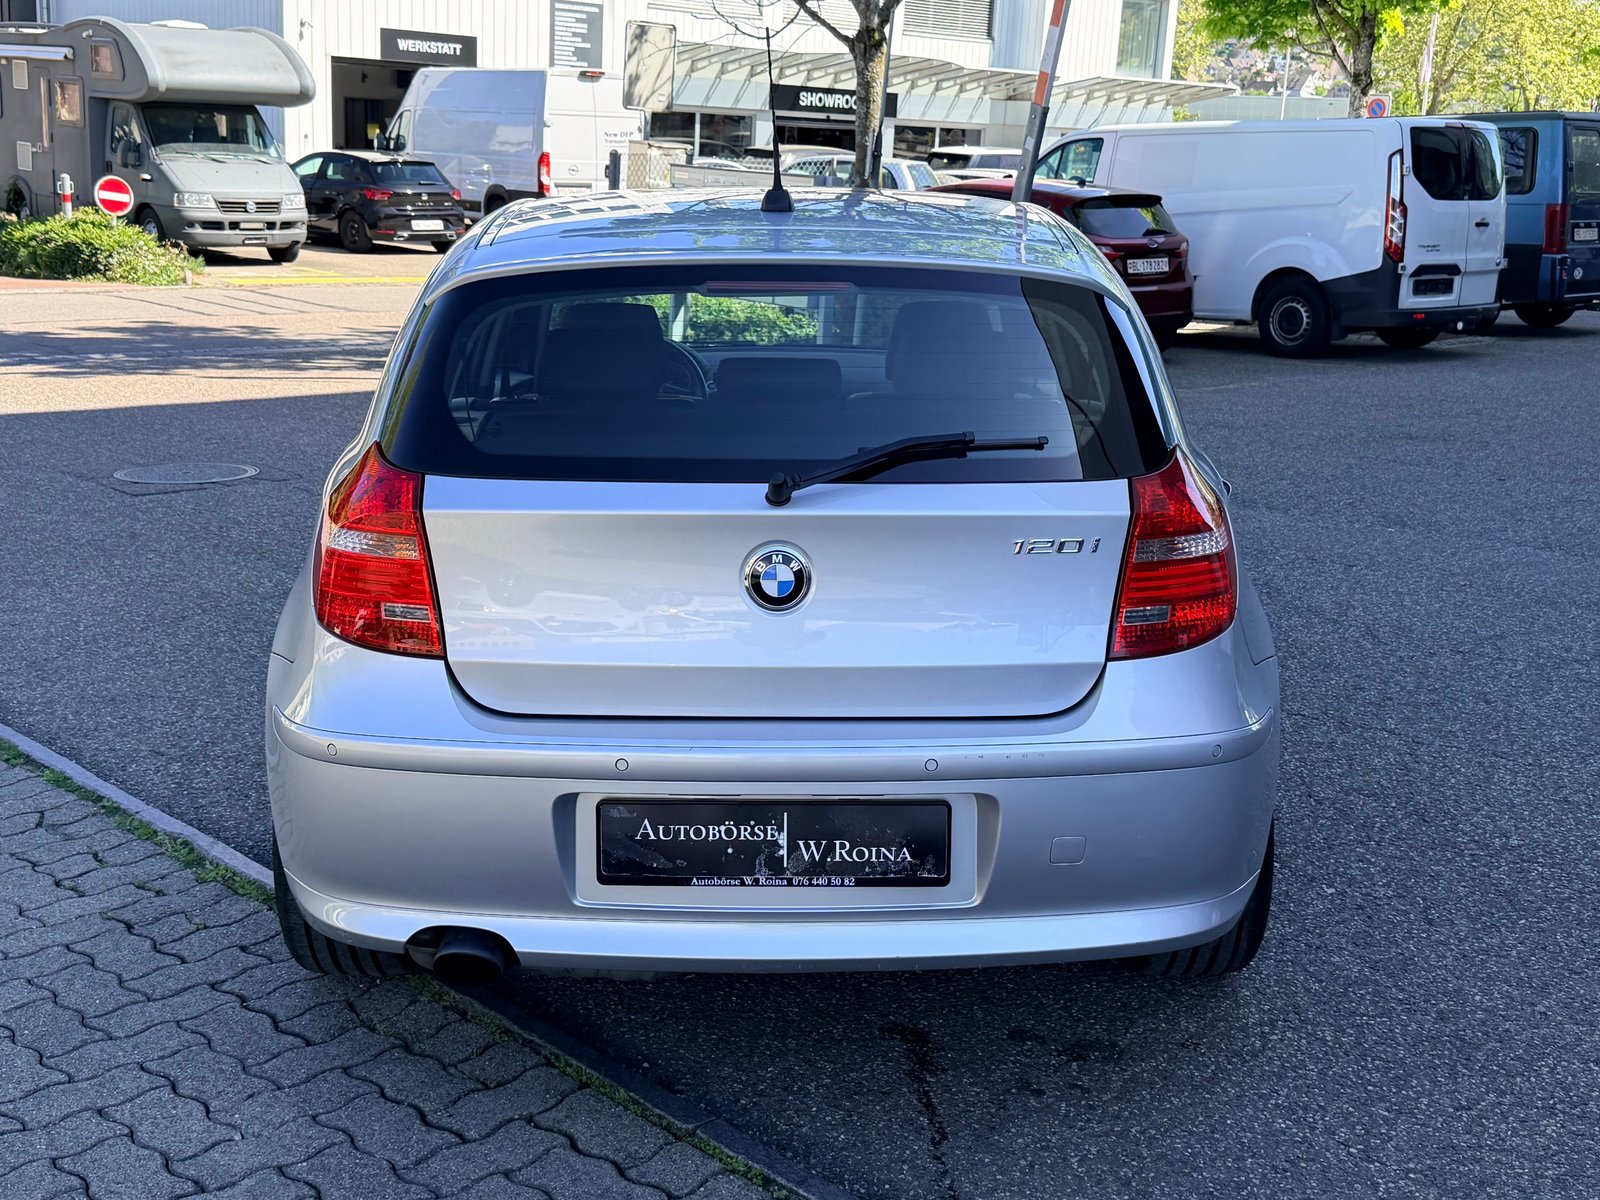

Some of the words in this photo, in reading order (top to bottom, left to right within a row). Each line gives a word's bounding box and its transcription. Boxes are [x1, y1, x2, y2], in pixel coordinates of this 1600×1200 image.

[397, 38, 463, 56] WERKSTATT
[755, 554, 801, 573] BMW
[691, 876, 741, 886] Autobörse
[743, 877, 756, 886] W.
[759, 877, 788, 886] Roina
[792, 877, 809, 886] 076
[811, 877, 828, 886] 440
[831, 877, 842, 886] 50
[844, 877, 855, 886] 82
